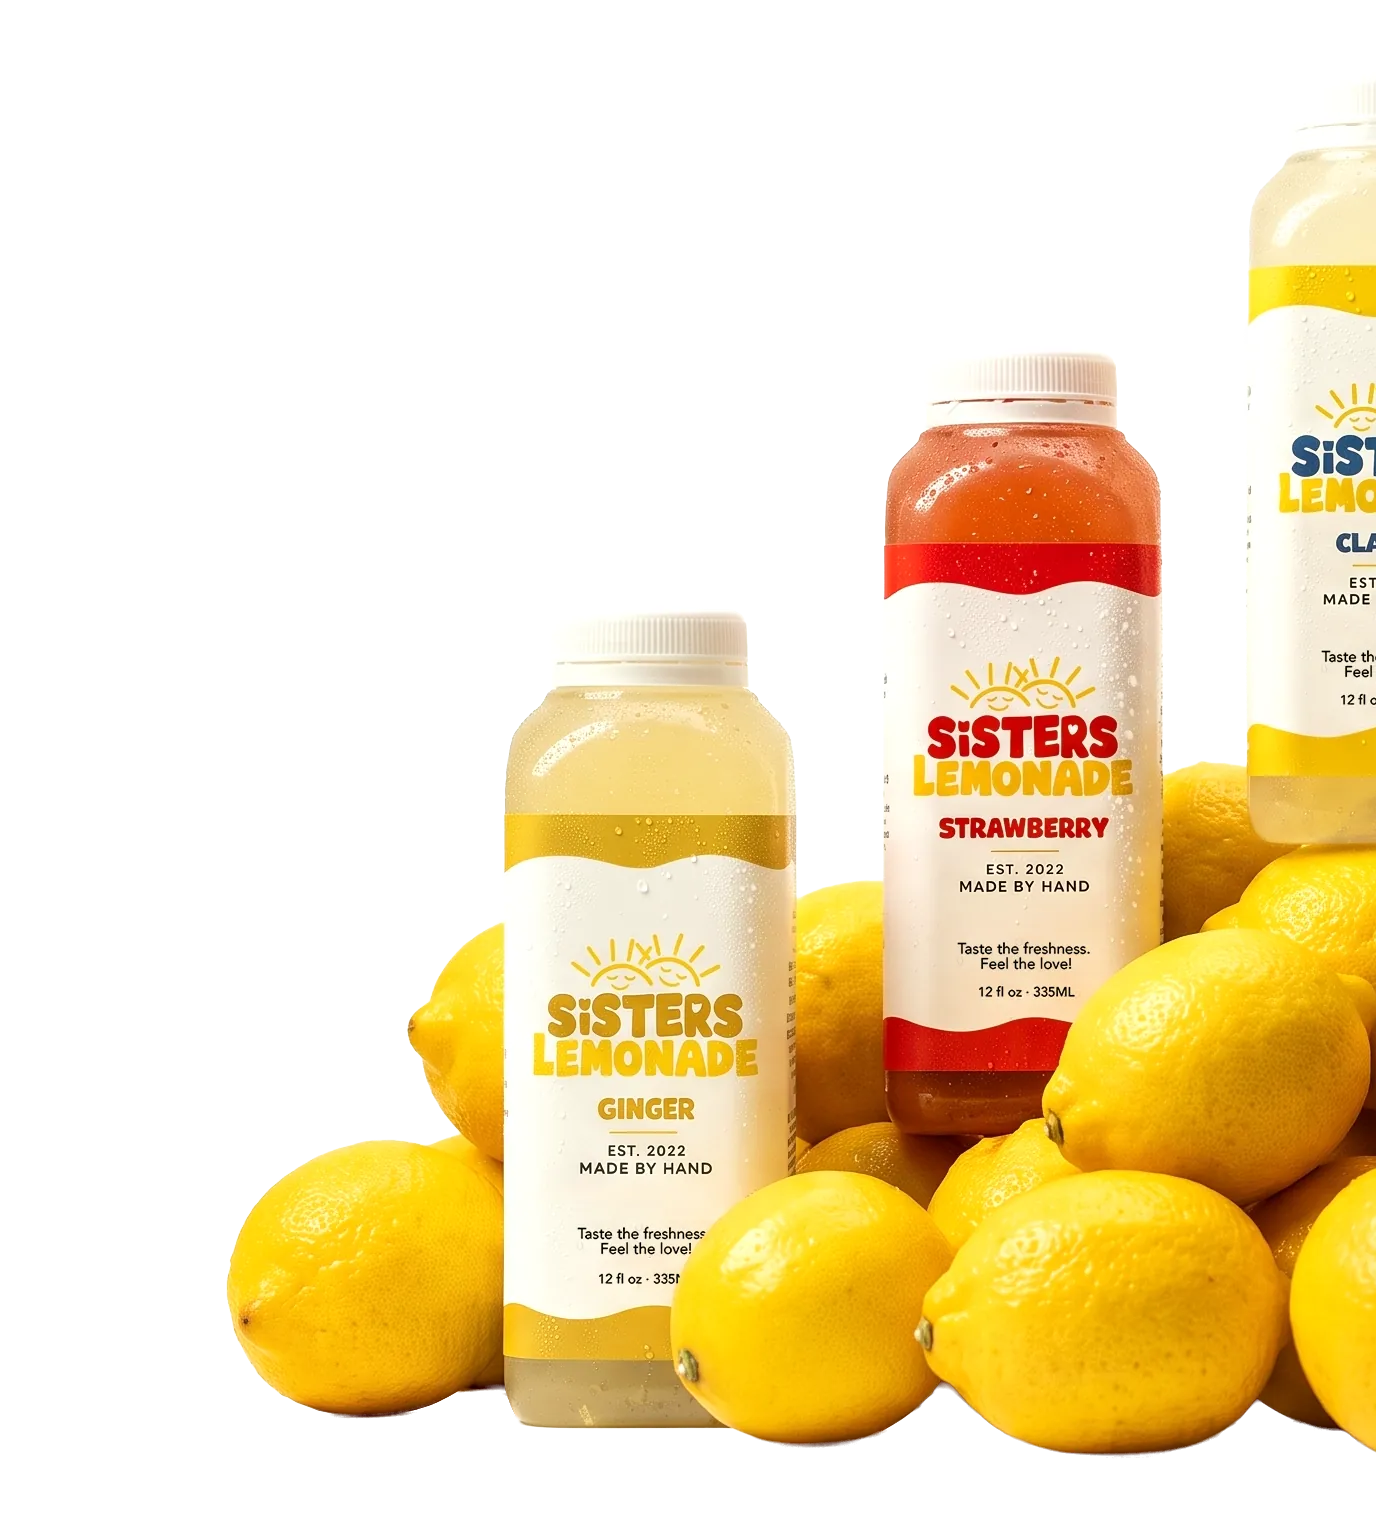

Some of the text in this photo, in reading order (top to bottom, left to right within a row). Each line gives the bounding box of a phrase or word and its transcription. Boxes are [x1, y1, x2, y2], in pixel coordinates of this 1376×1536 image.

[1323, 593, 1371, 606] MADE
[1321, 650, 1357, 663] Taste
[1344, 664, 1373, 678] Feel
[1340, 693, 1355, 706] 12
[1357, 693, 1366, 706] fl
[913, 754, 1133, 796] LEMONADE
[939, 817, 1109, 839] STRAWBERRY
[986, 863, 1064, 875] EST. 2022
[959, 880, 1090, 893] MADE BY HAND
[957, 941, 1091, 955] Taste the freshness.
[980, 956, 1072, 970] Feel the love!
[978, 985, 1076, 998] 12 fl oz 335ML
[533, 1033, 758, 1077] LEMONADE
[598, 1098, 694, 1119] GINGER
[608, 1144, 686, 1157] EST. 2022
[579, 1161, 713, 1175] MADE BY HAND
[577, 1227, 613, 1240] Taste
[616, 1226, 640, 1240] the
[600, 1241, 693, 1255] Feel the love!
[598, 1272, 613, 1285] 12
[615, 1272, 624, 1285] fl
[627, 1276, 643, 1285] oz
